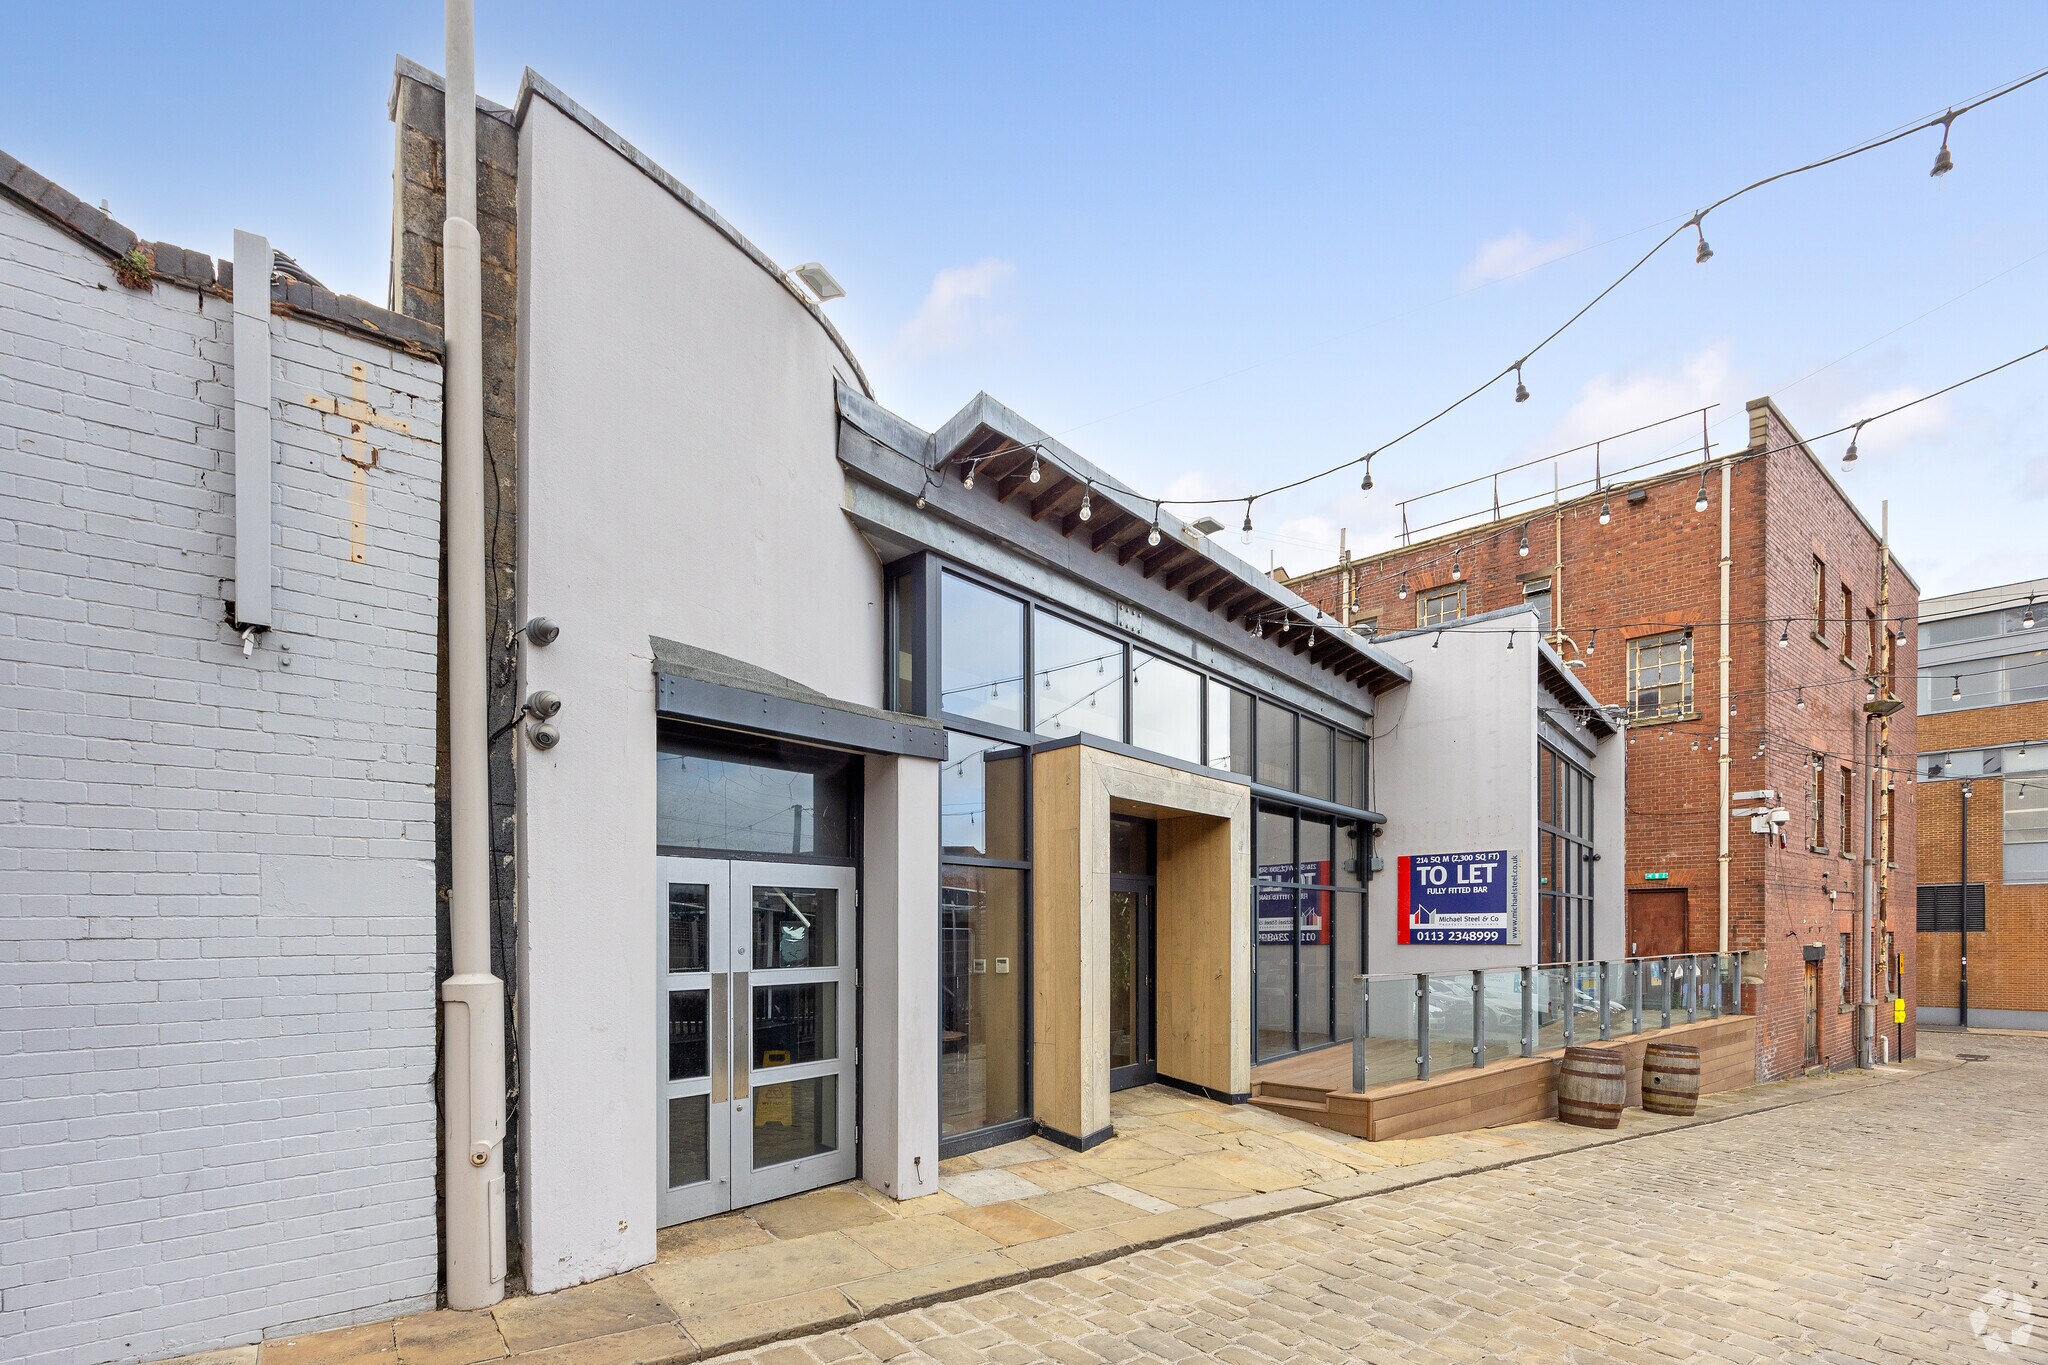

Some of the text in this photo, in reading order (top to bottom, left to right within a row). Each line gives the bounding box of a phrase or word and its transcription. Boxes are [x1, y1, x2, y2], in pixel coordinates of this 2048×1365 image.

[1430, 856, 1441, 864] SQ
[1452, 854, 1473, 863] (2,300
[1475, 853, 1487, 861] SQ
[1488, 852, 1499, 860] FT)
[1416, 863, 1498, 885] TO LET
[1427, 887, 1447, 895] FULLY
[1417, 931, 1499, 941] 0113 2348999
